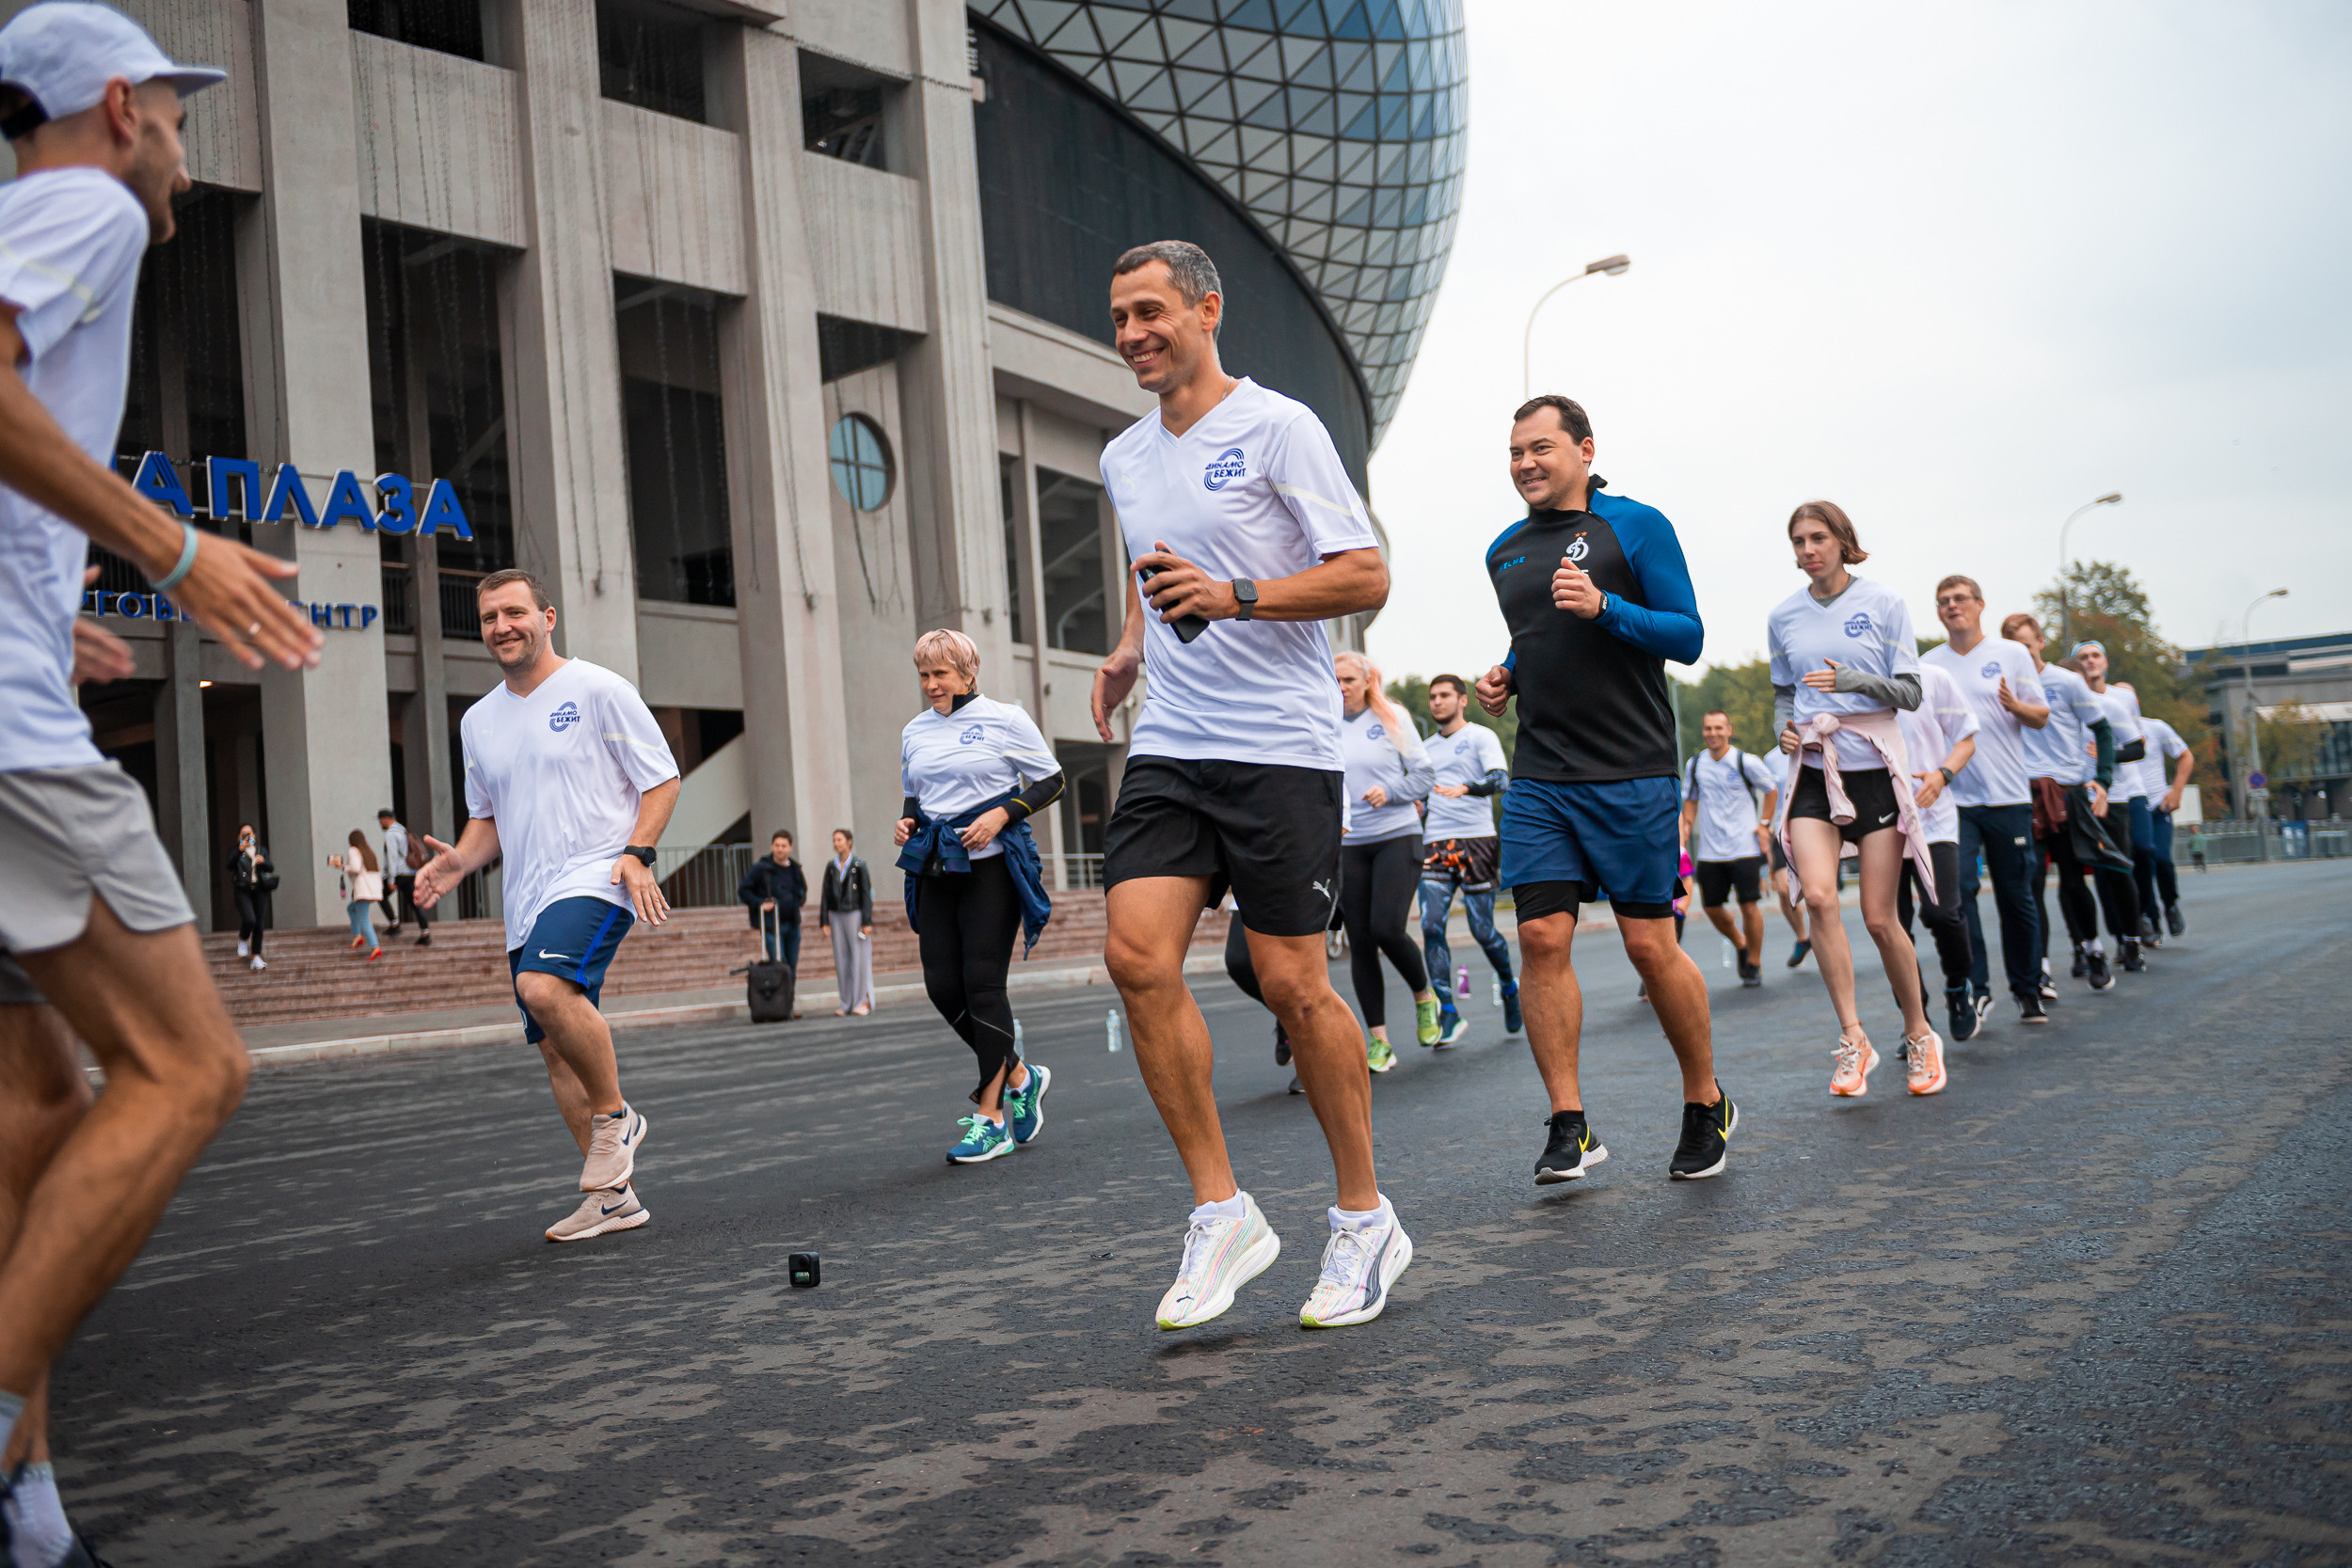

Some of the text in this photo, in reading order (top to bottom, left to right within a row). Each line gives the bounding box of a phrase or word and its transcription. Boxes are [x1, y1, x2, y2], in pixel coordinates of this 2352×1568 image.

[1204, 460, 1245, 470] ДИНАМО
[1214, 467, 1247, 478] БЕЖИТ
[206, 454, 474, 542] ПЛАЗА
[286, 600, 378, 630] НТР
[556, 715, 580, 723] БЕЖИТ
